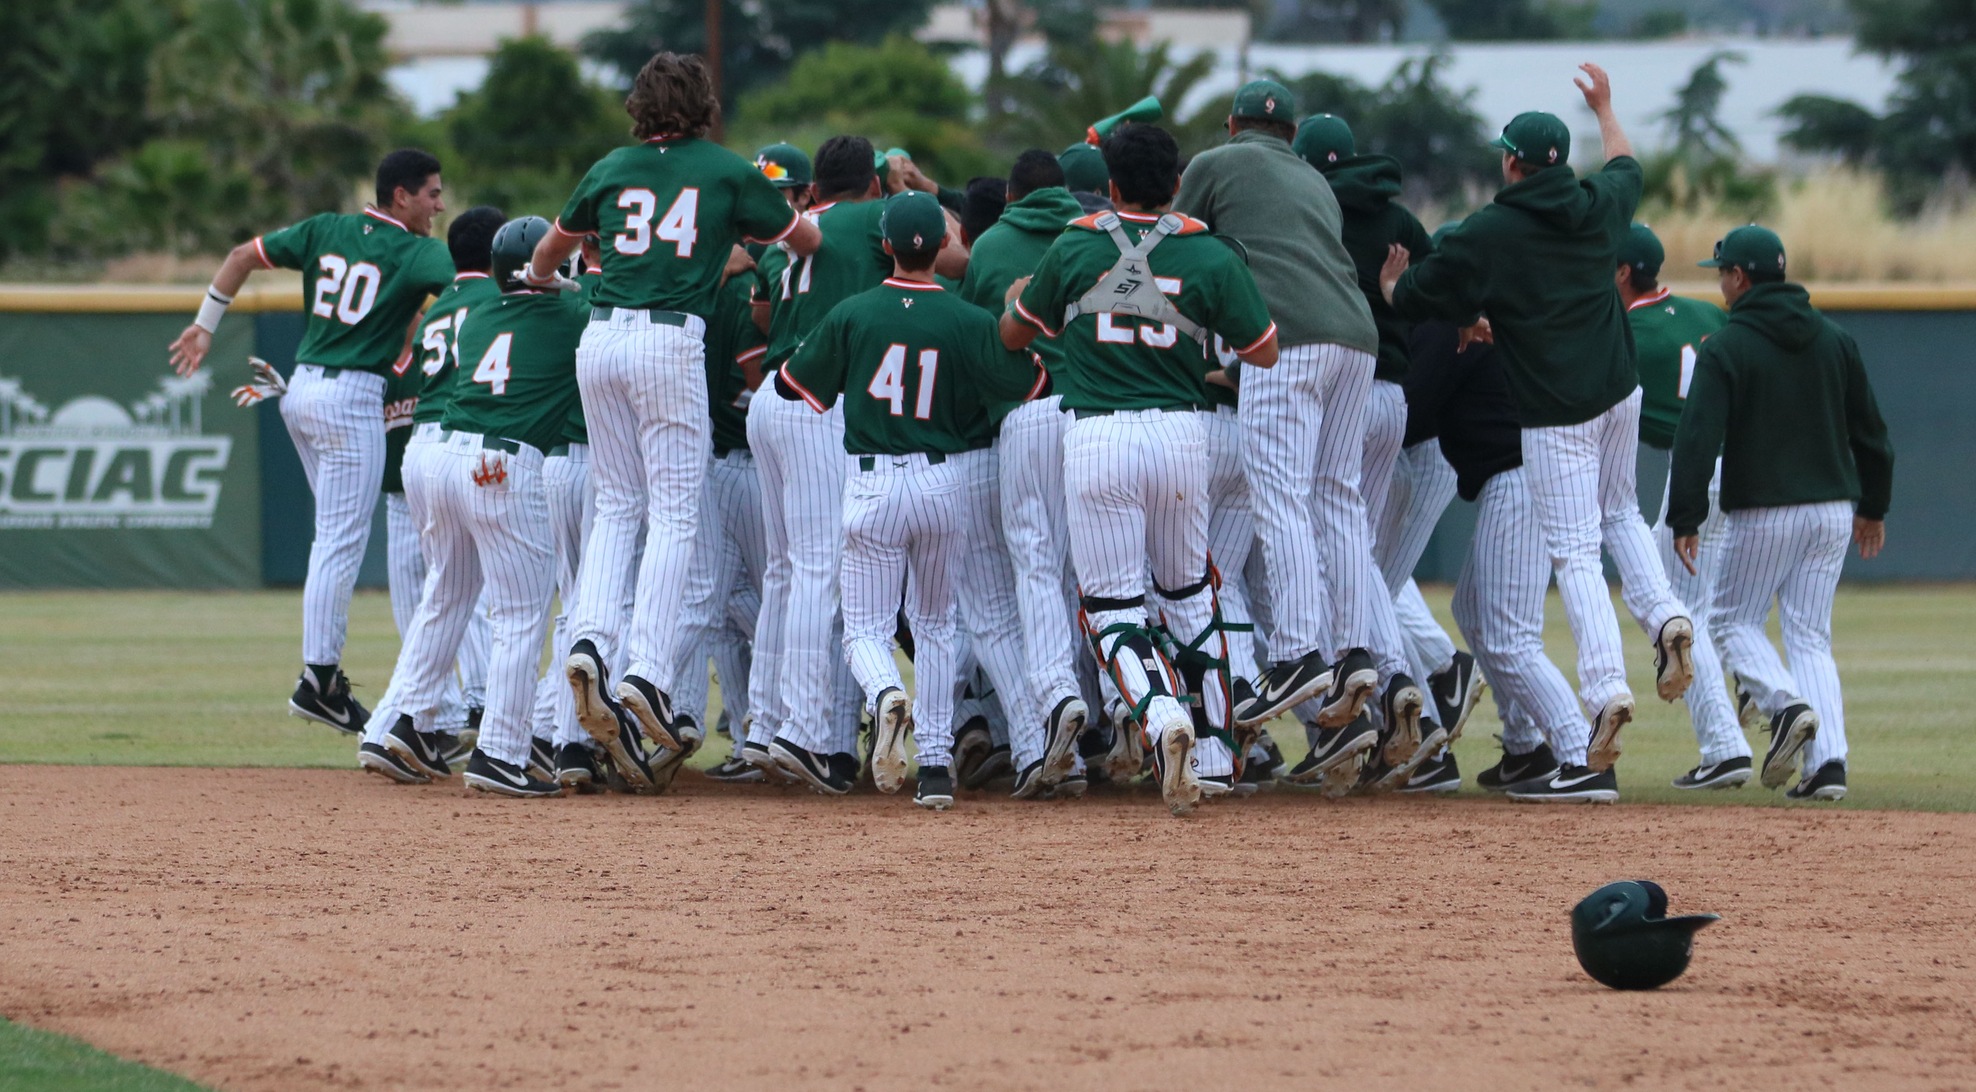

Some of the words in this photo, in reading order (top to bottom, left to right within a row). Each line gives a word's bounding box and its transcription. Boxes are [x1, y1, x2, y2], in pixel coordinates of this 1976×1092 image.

[614, 187, 700, 258] 34
[313, 253, 382, 325] 20
[472, 331, 514, 396] 4
[867, 342, 940, 420] 41
[0, 448, 222, 502] CIAC
